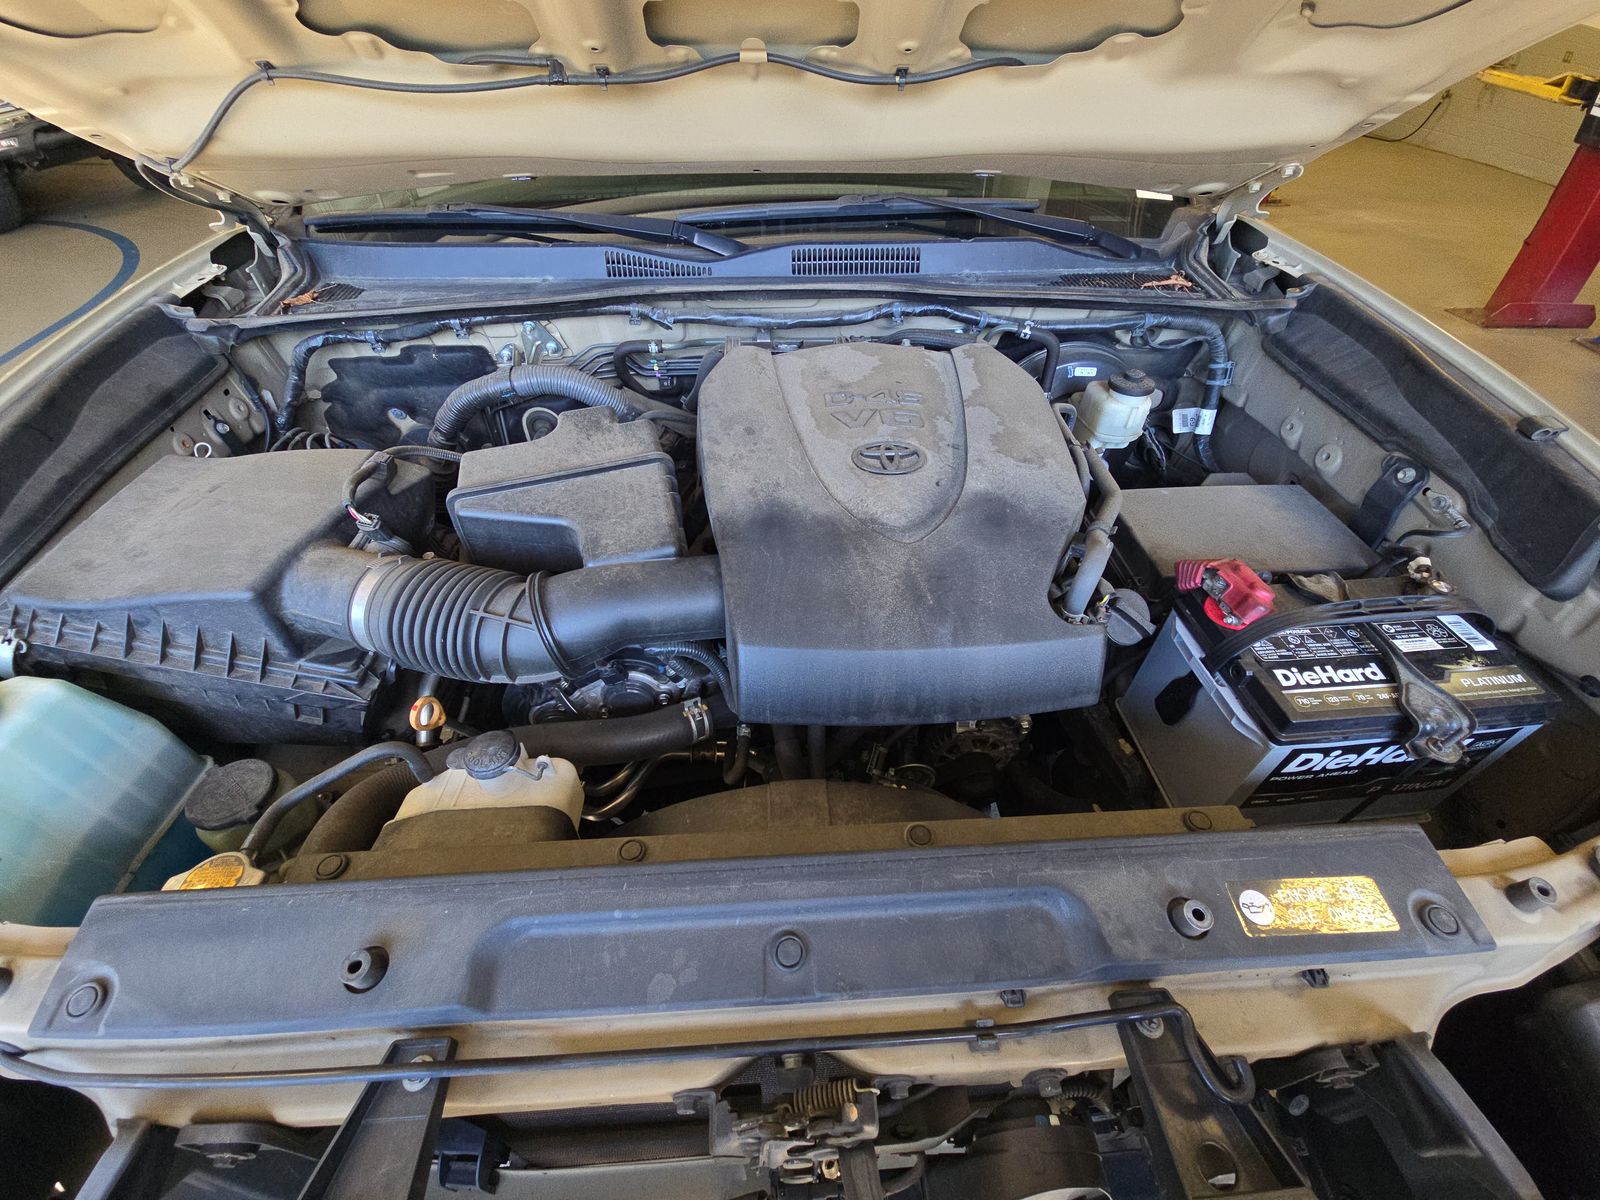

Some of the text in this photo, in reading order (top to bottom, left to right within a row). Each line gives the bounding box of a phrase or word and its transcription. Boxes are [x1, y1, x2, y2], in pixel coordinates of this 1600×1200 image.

[830, 408, 925, 429] V6
[1272, 662, 1387, 687] DieHard
[1460, 674, 1527, 688] PLATINUM
[1269, 769, 1360, 782] POWER AHEAD
[1287, 908, 1321, 923] SAE
